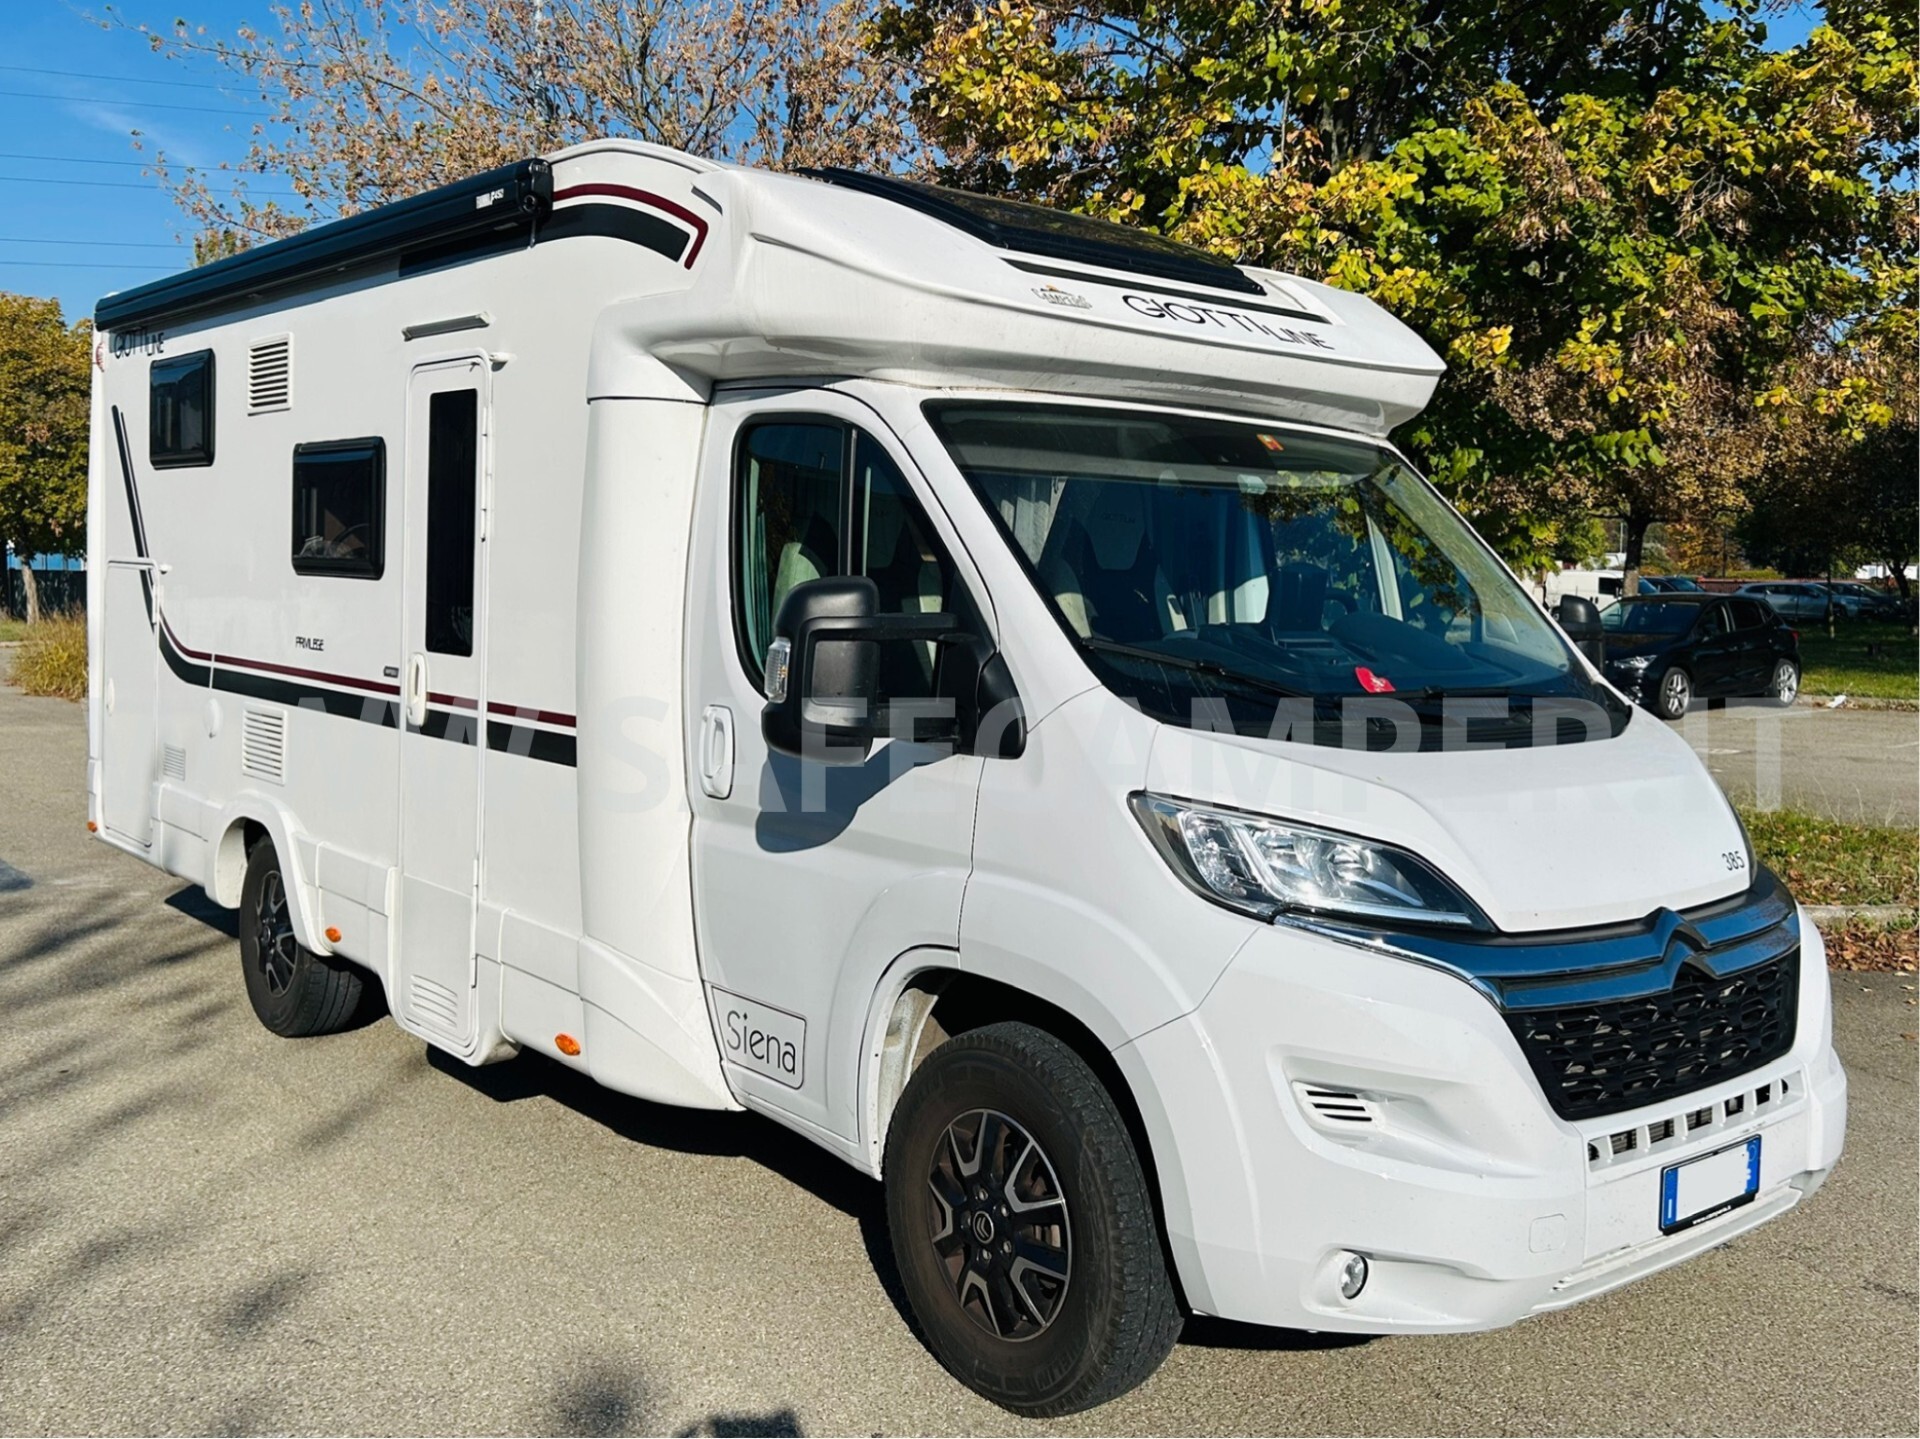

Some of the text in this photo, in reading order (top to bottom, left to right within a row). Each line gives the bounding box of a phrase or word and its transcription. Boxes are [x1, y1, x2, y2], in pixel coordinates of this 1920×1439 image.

[1121, 294, 1335, 351] GIOTTILINE
[1721, 850, 1746, 871] 385
[726, 1009, 796, 1075] Siena
